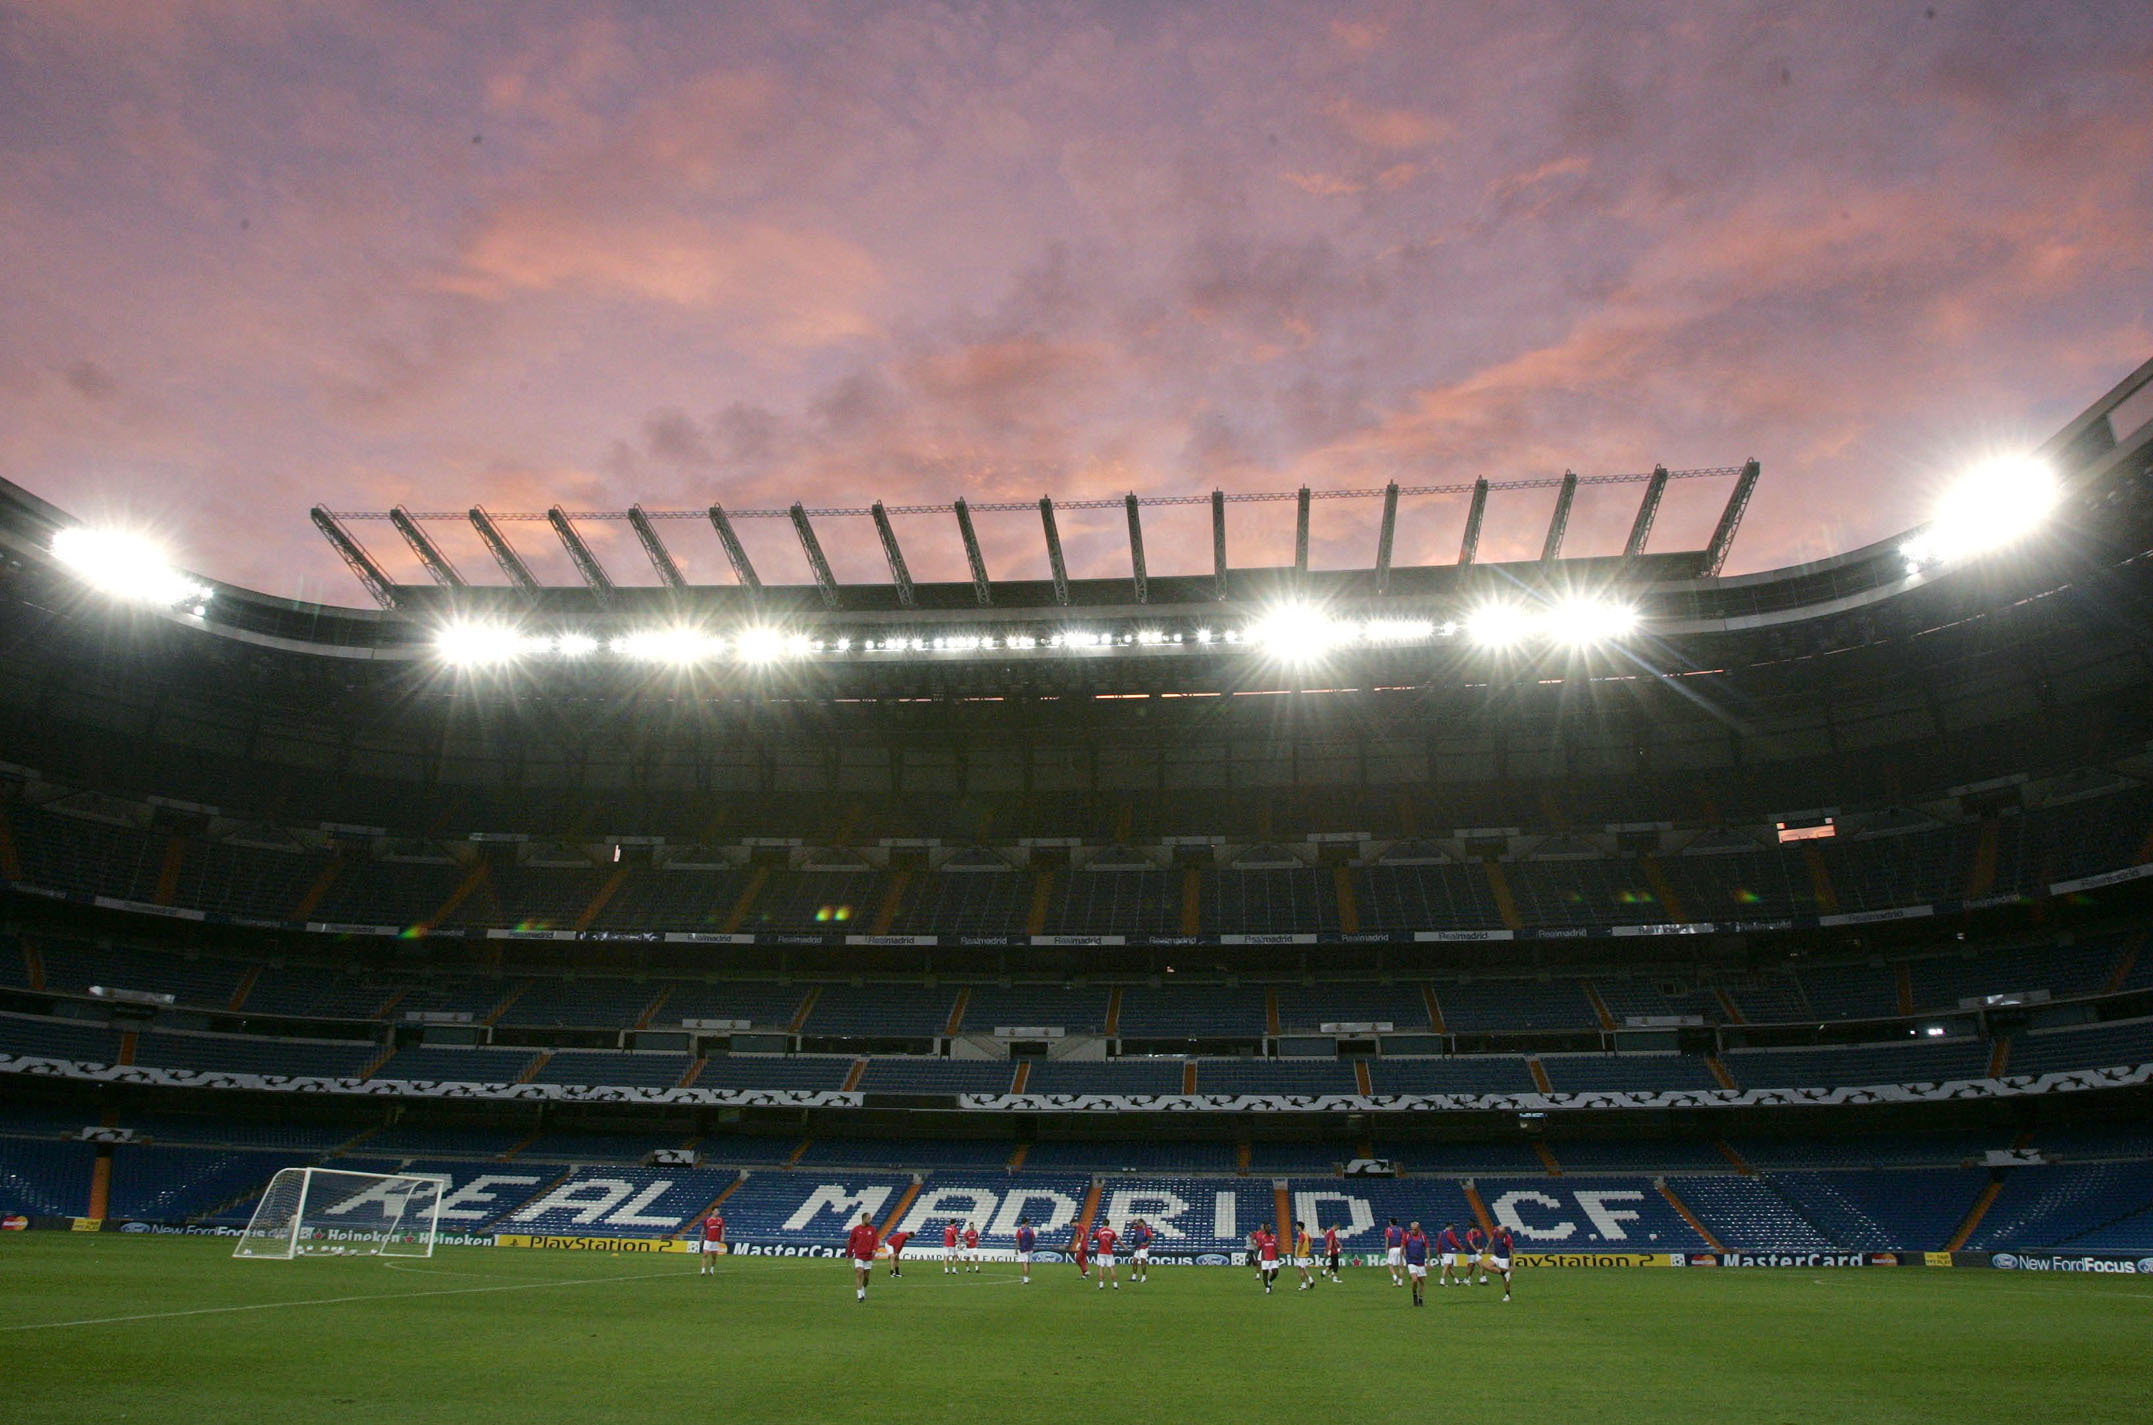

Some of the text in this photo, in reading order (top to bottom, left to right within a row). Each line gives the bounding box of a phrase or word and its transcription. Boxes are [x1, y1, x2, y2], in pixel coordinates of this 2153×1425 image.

[325, 1171, 682, 1228] REAL
[782, 1184, 1376, 1239] MADRID
[327, 1229, 401, 1243] Heineken
[529, 1236, 651, 1252] PlayStation
[733, 1242, 847, 1258] MasterCar
[902, 1254, 970, 1262] CHAMPNS
[1514, 1254, 1630, 1268] ayStation
[1723, 1253, 1863, 1267] MasterCard
[2019, 1255, 2050, 1271] New
